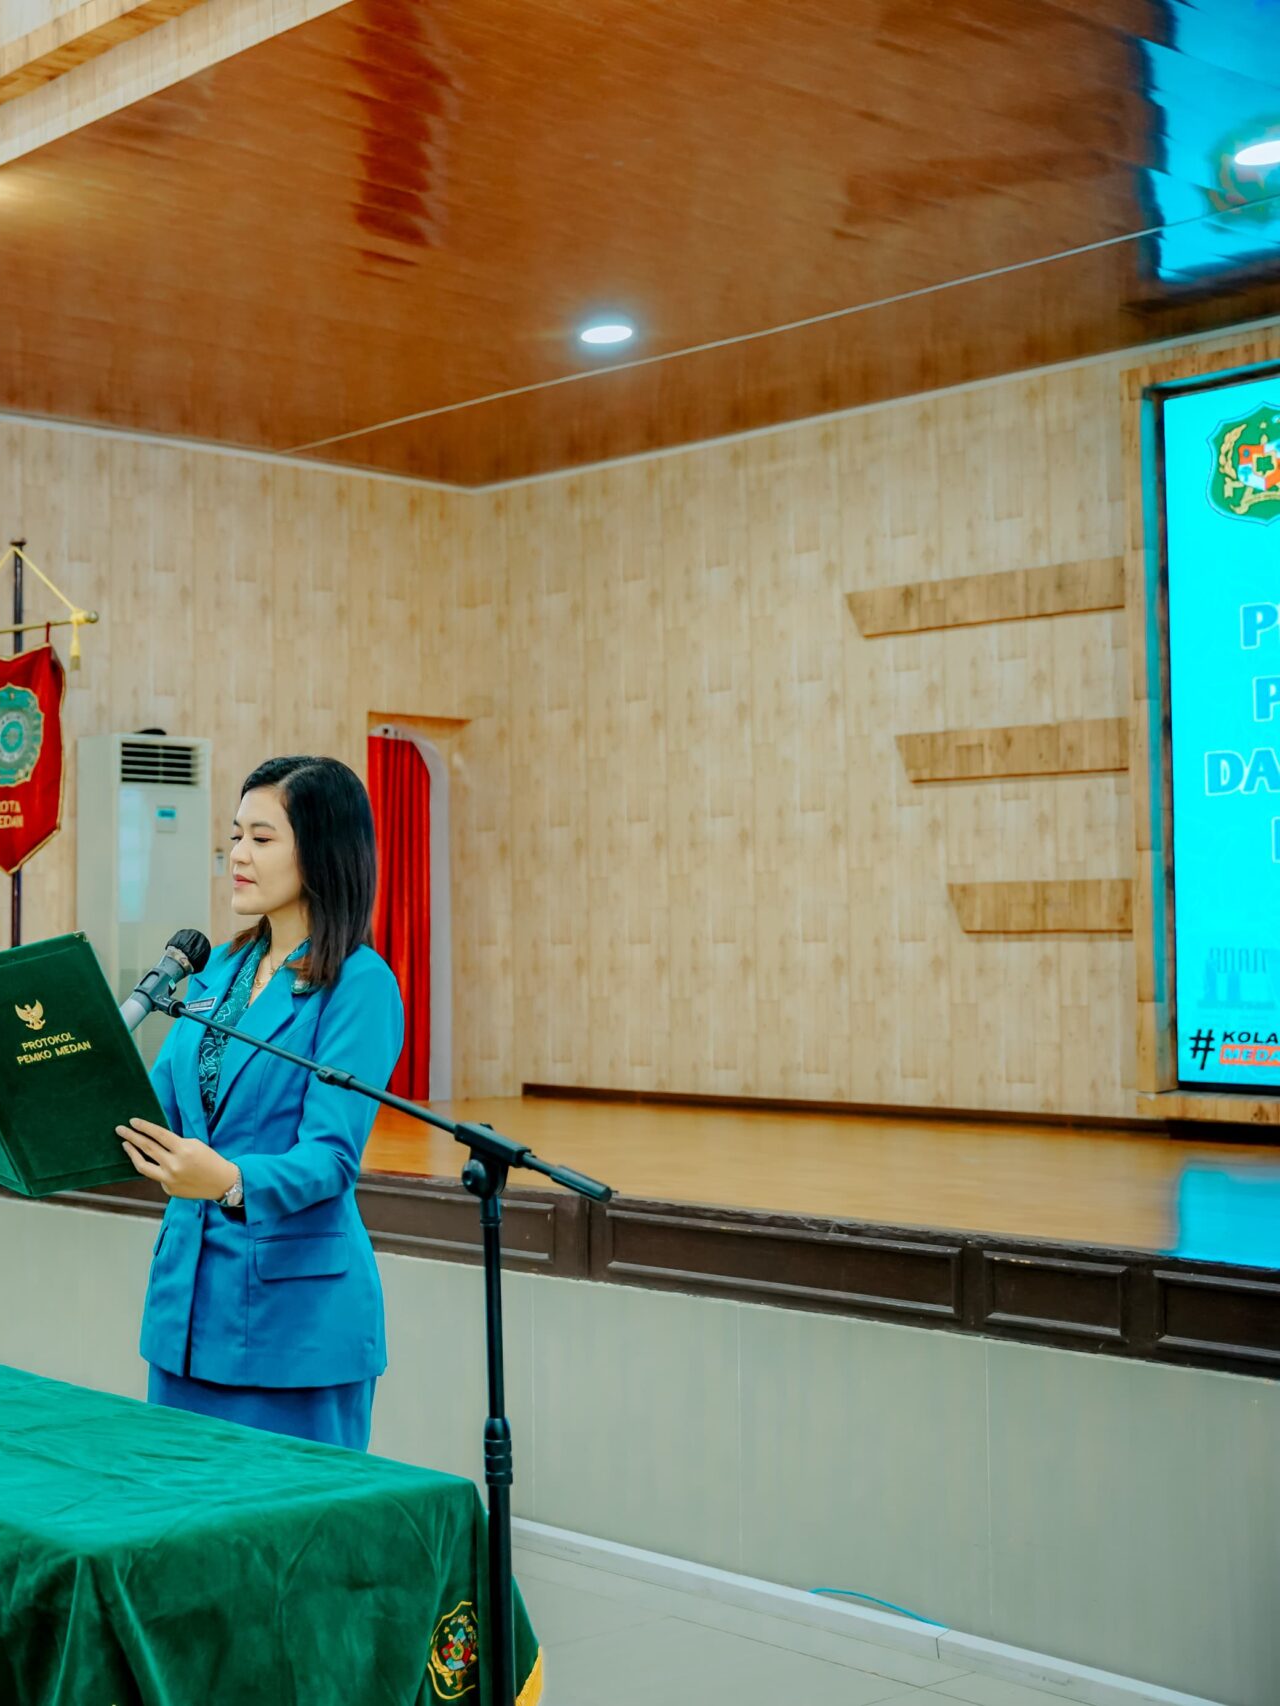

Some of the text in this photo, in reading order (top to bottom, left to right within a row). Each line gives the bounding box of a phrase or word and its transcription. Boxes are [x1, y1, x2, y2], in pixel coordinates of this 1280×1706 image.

[1240, 601, 1280, 650] P
[1204, 747, 1280, 796] DA
[16, 1040, 92, 1065] PEMKO MEDAN
[21, 1032, 76, 1052] PROTOKOL
[1223, 1047, 1280, 1063] MEDA
